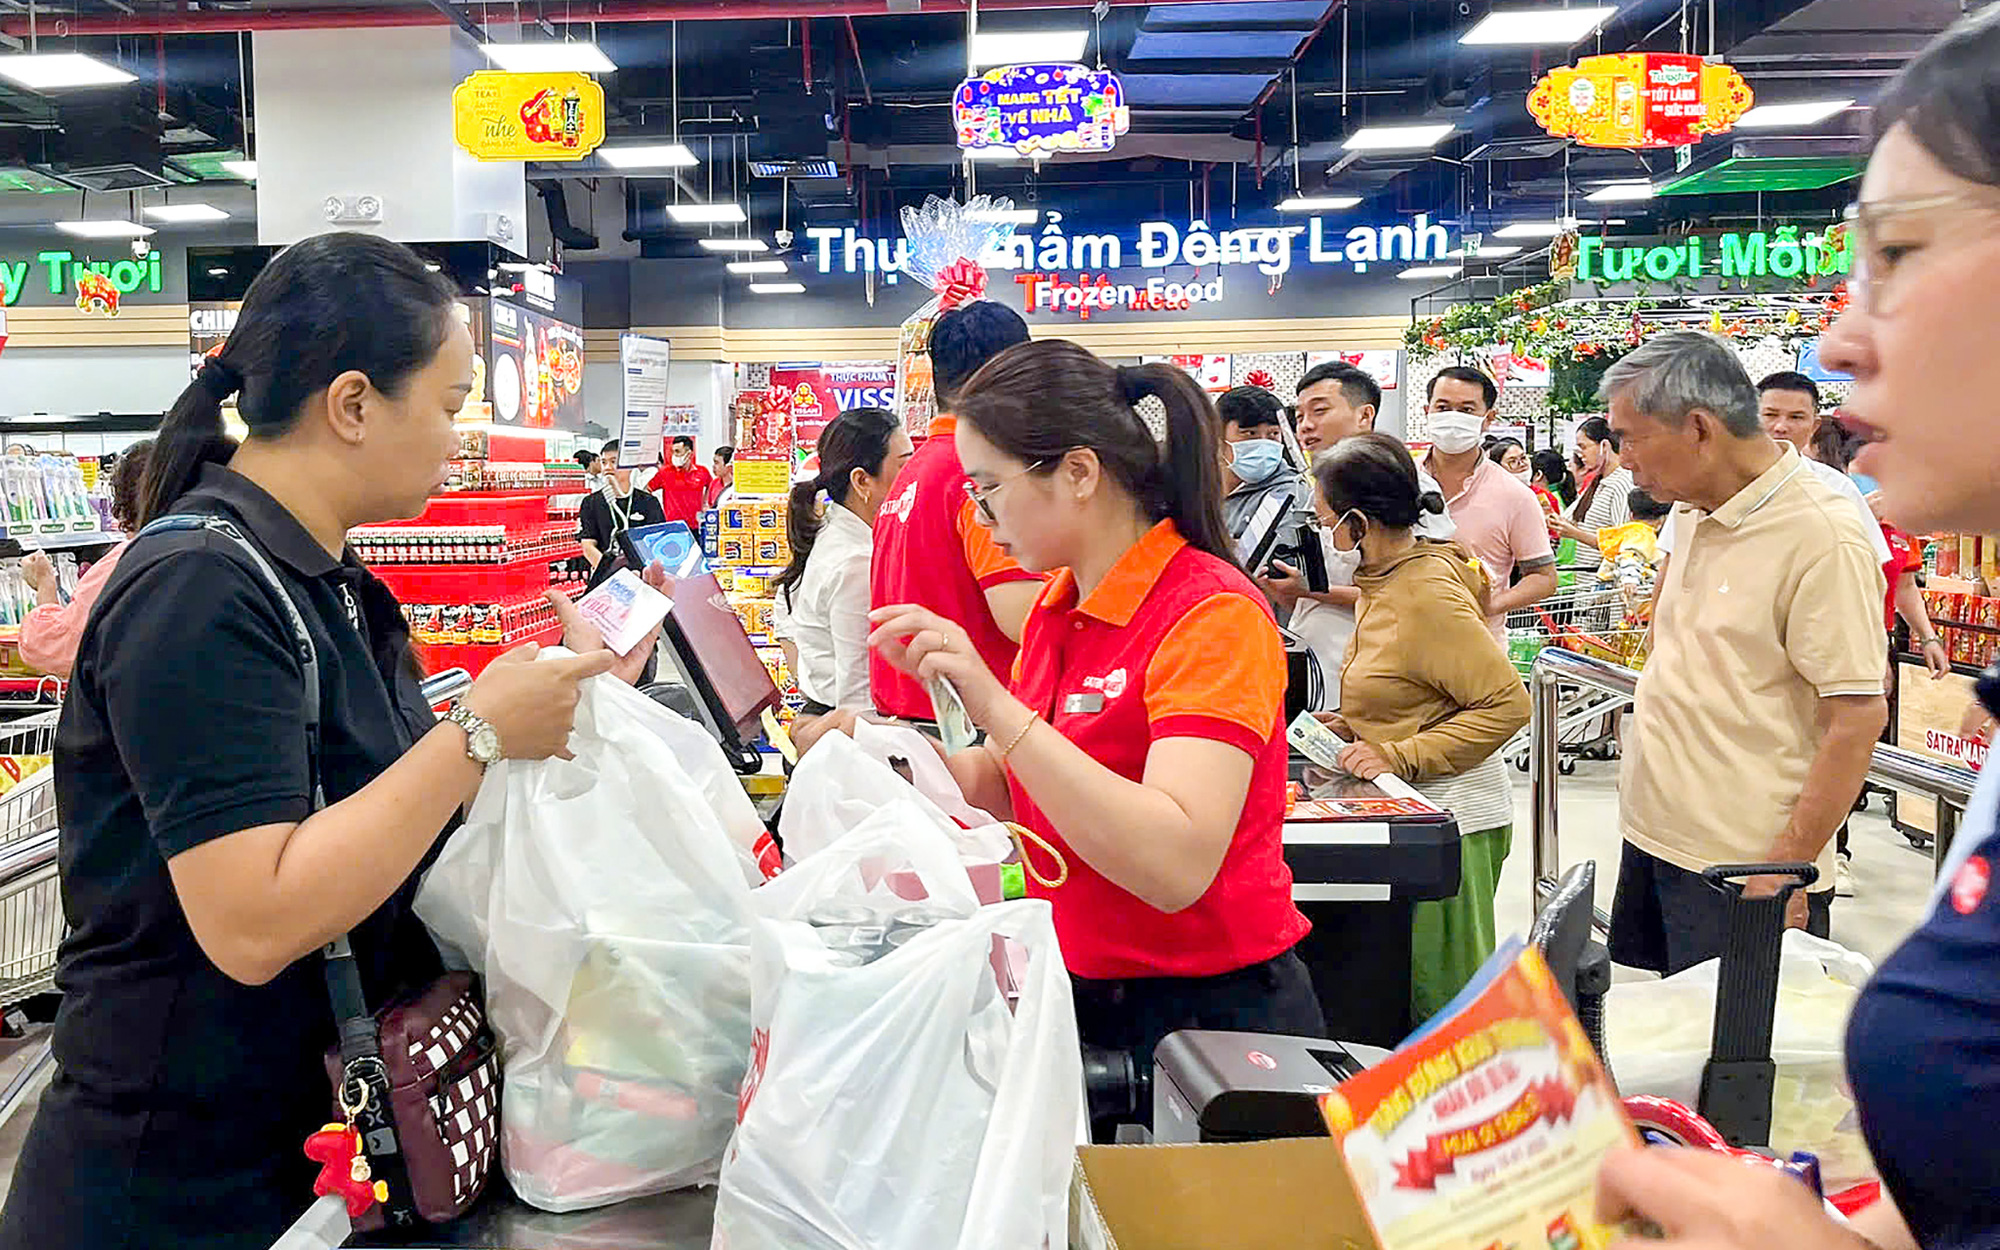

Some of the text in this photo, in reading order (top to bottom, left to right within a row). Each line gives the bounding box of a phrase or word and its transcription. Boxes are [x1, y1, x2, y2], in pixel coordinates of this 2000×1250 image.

[997, 84, 1082, 106] MANG TẾT
[1029, 104, 1073, 125] NHÀ
[985, 210, 1122, 271] hẩm
[1309, 213, 1449, 274] Lạnh
[1577, 236, 1702, 281] Tươi
[1719, 224, 1817, 279] Mỗi
[1034, 276, 1224, 308] Frozen Food
